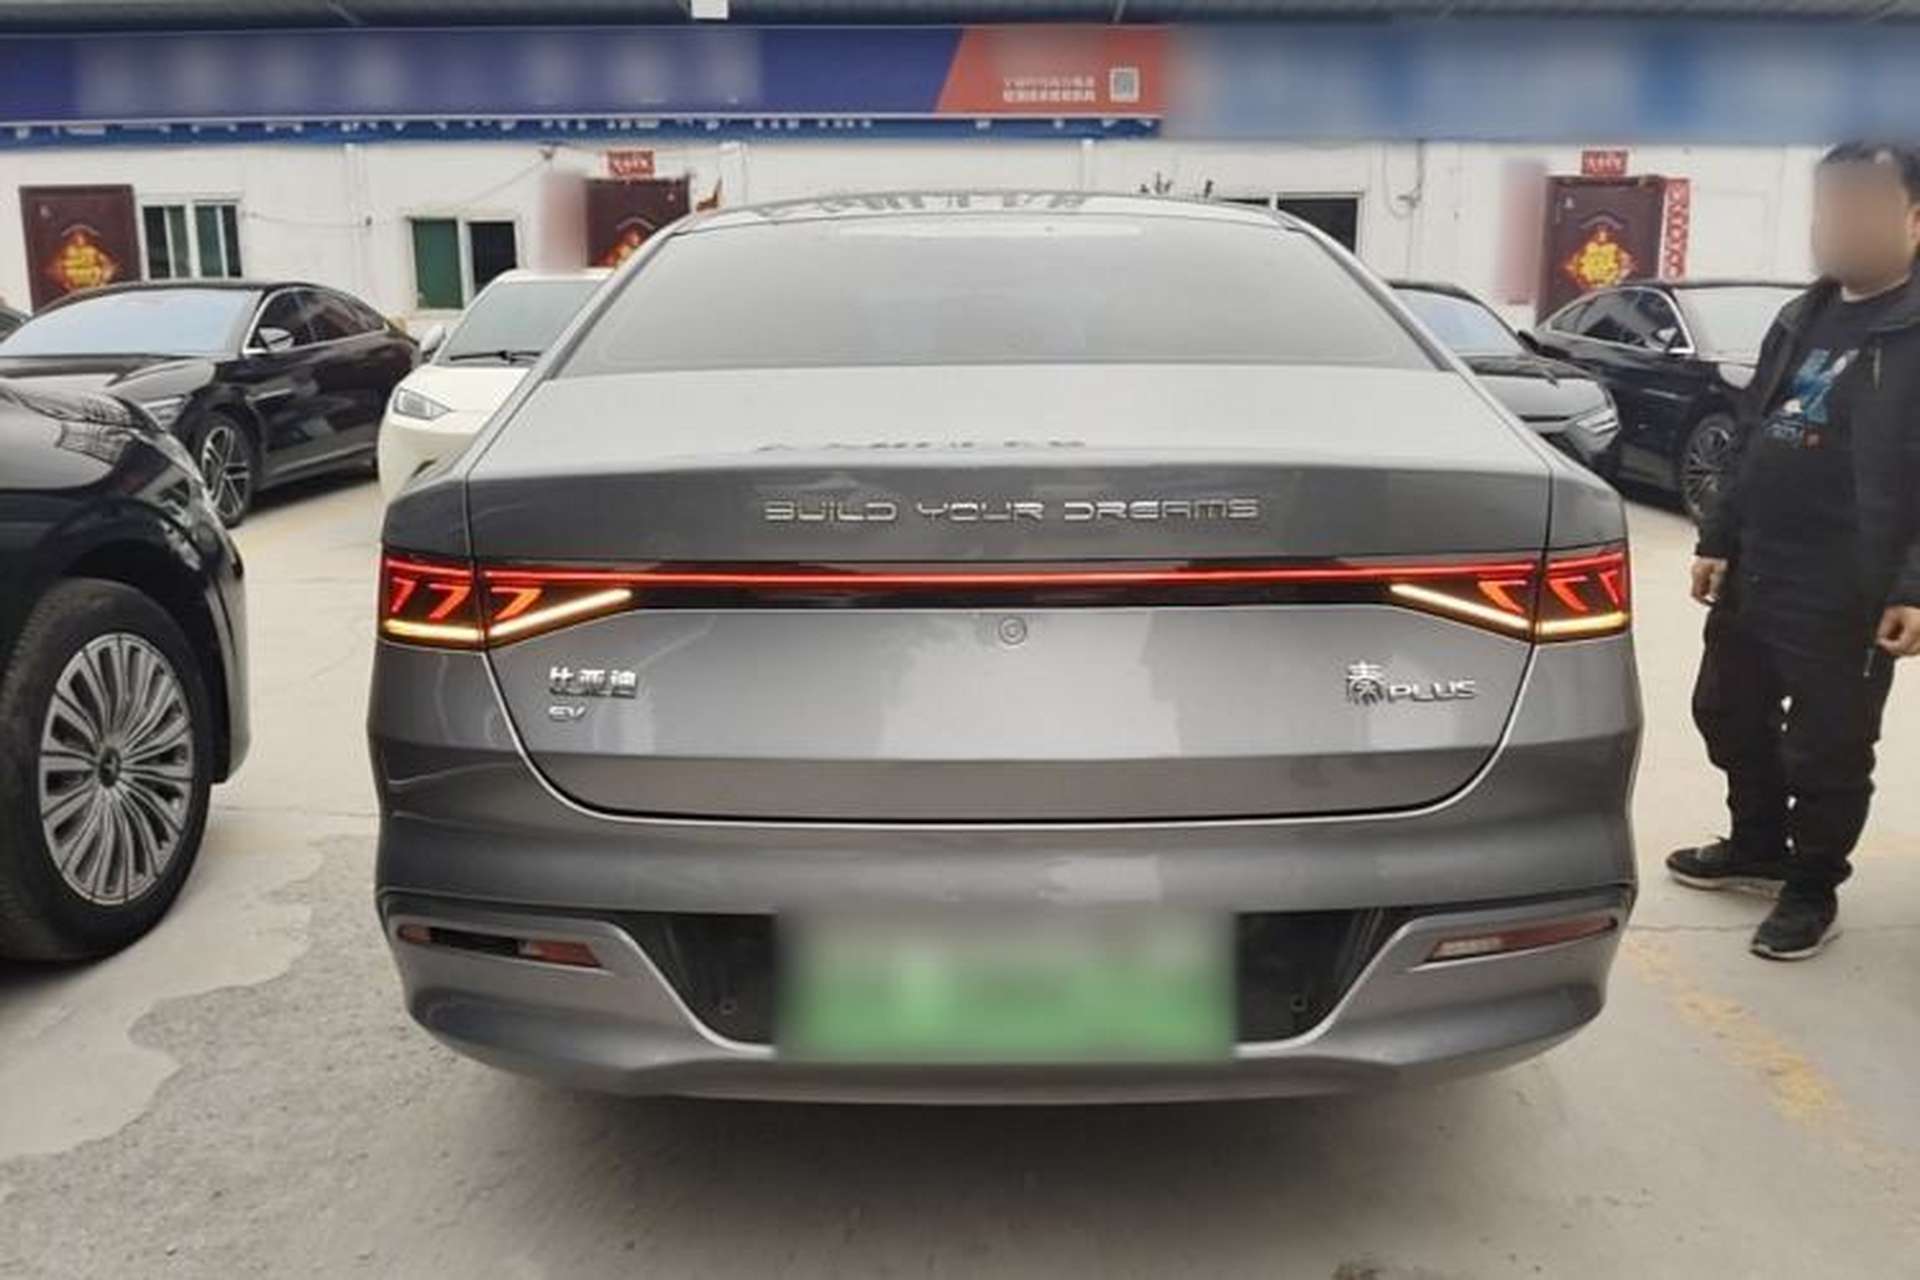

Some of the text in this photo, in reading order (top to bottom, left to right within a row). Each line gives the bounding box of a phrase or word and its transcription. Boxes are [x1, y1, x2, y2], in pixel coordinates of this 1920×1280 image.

[764, 499, 1259, 522] BUILD YOUR DREAMS
[549, 666, 637, 699] 比亚迪
[548, 705, 586, 722] EV
